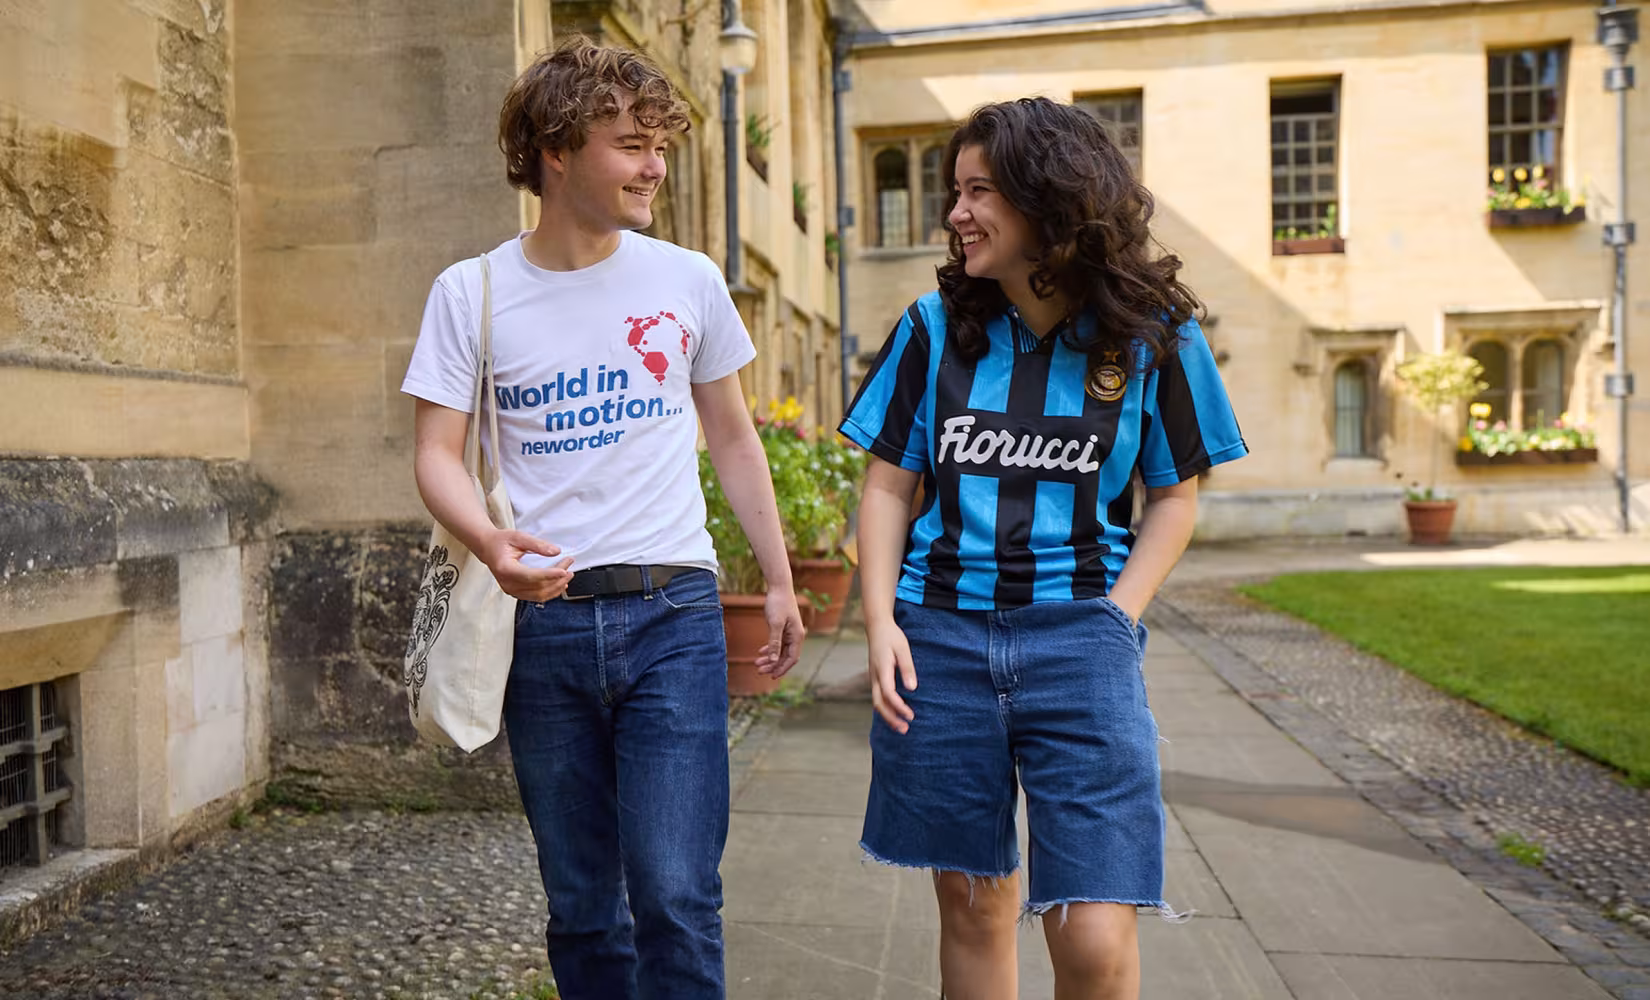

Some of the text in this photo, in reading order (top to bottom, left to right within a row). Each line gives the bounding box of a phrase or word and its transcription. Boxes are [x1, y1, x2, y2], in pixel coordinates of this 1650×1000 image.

[495, 365, 629, 410] World in
[545, 394, 683, 432] motion...
[521, 429, 625, 455] neworder
[937, 415, 1099, 474] Fiorucci
